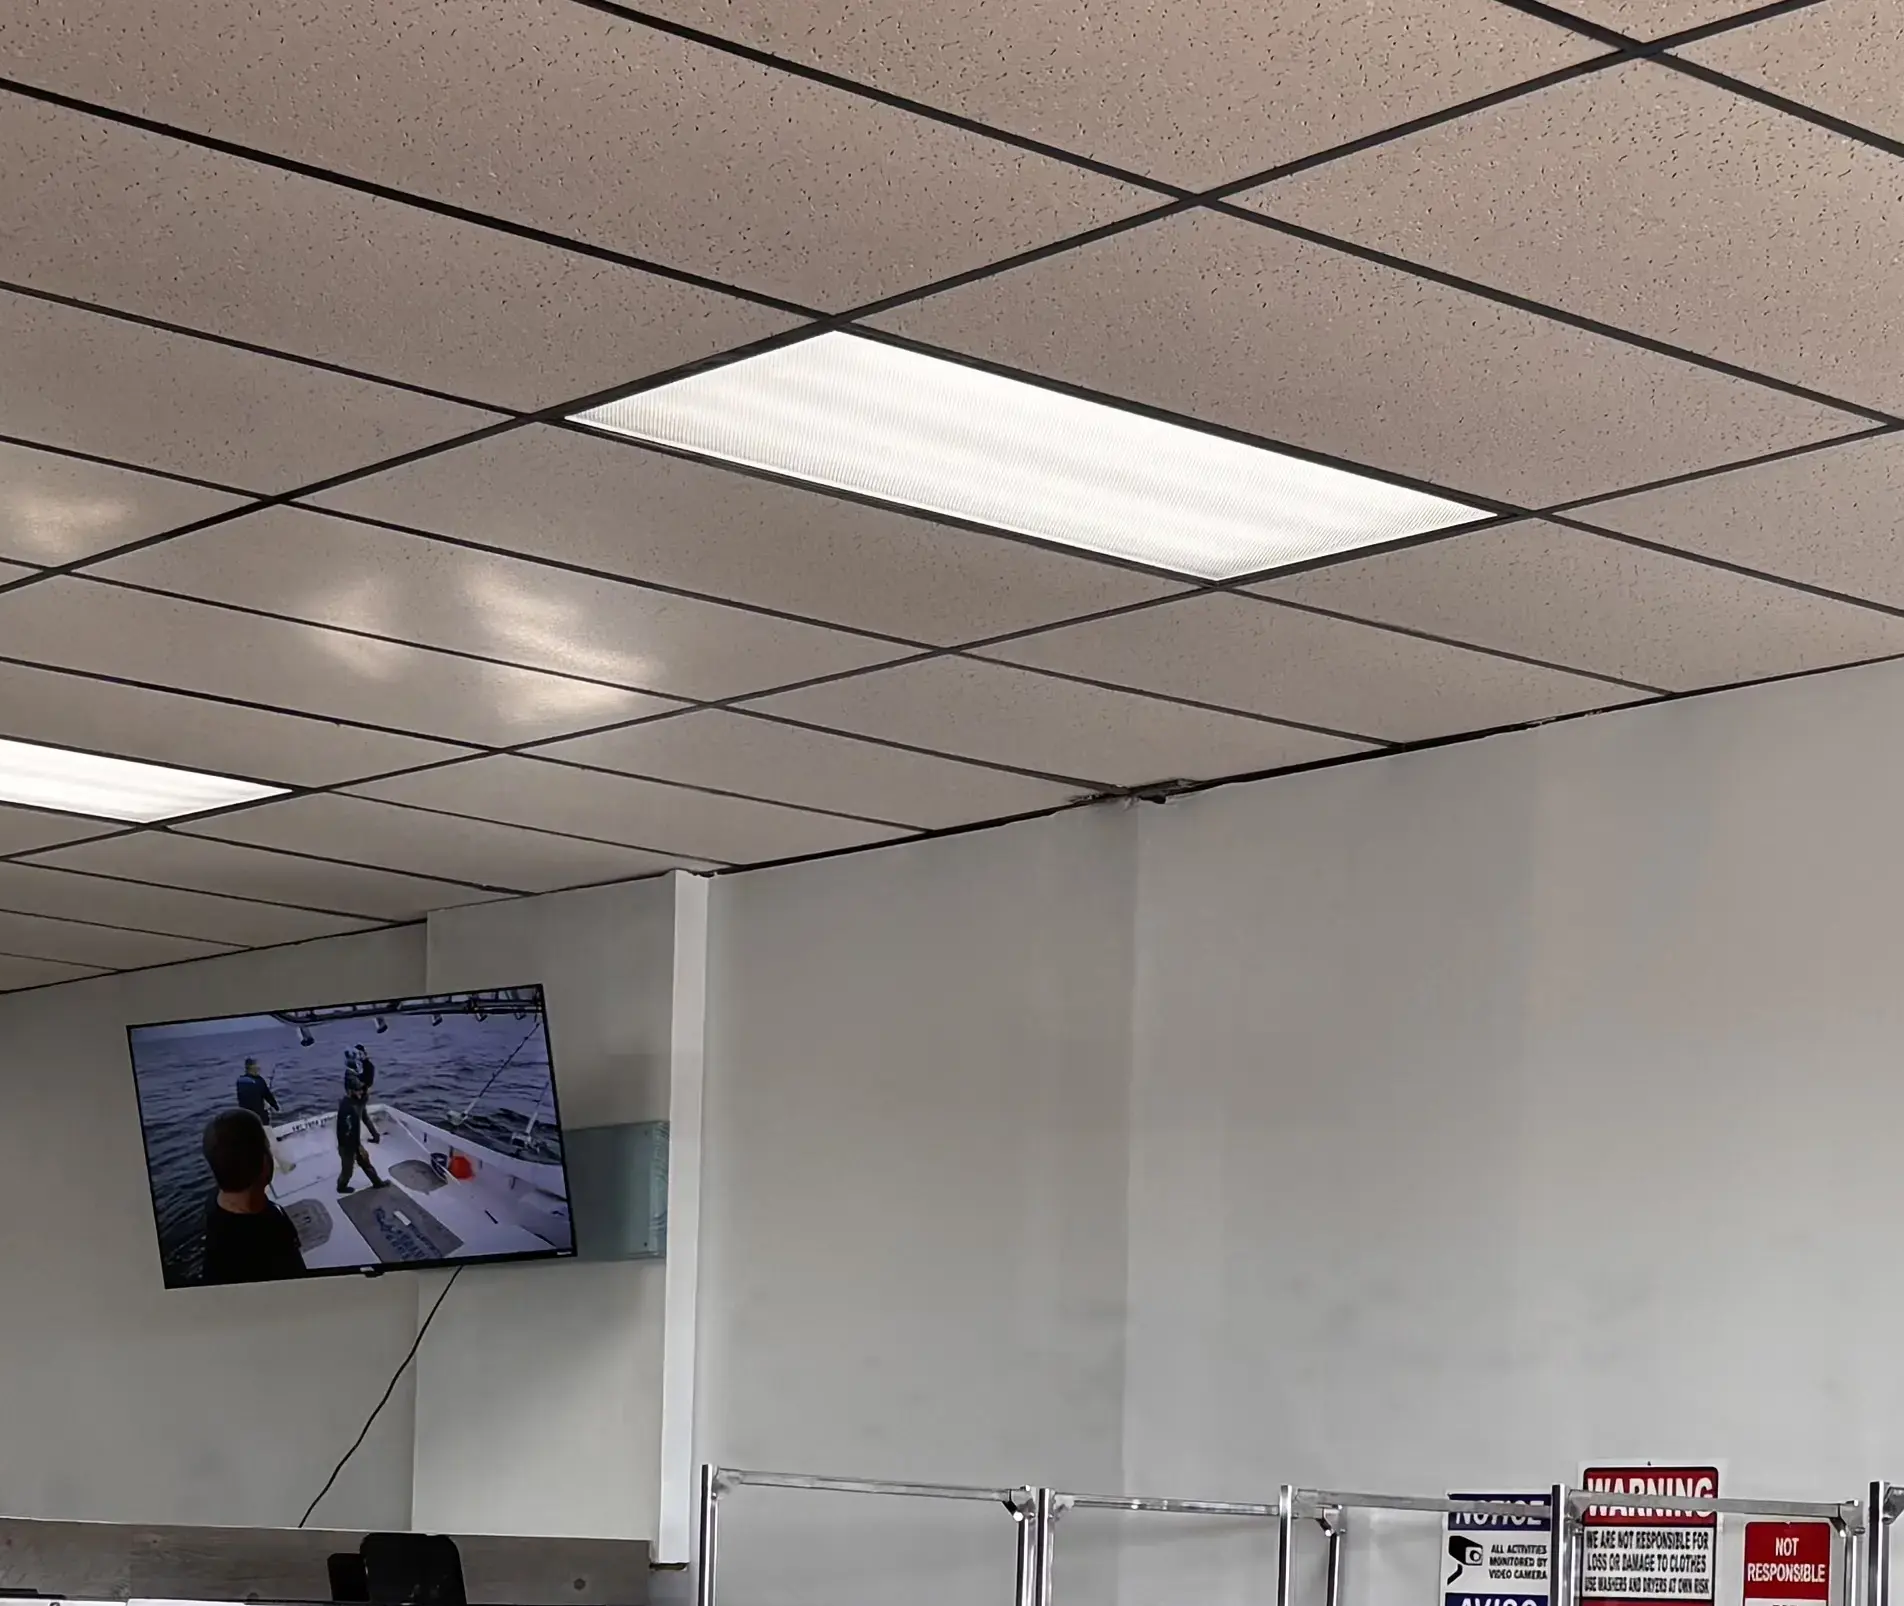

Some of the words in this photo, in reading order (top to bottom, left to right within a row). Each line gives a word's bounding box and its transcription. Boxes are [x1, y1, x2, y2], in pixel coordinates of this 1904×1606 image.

[1587, 1477, 1713, 1517] WARNING
[1491, 1544, 1504, 1554] ALL
[1586, 1530, 1598, 1549] WE
[1600, 1530, 1616, 1549] ARE
[1618, 1530, 1634, 1549] NOT
[1636, 1530, 1690, 1550] RESPONSIBLE
[1692, 1531, 1709, 1550] FOR
[1775, 1537, 1799, 1557] NOT
[1587, 1553, 1607, 1571] LOSS
[1609, 1553, 1621, 1571] OR
[1622, 1553, 1655, 1572] DAMAGE
[1657, 1553, 1667, 1572] TO
[1670, 1554, 1706, 1573] CLOTHES
[1747, 1563, 1826, 1583] RESPONSIBLE
